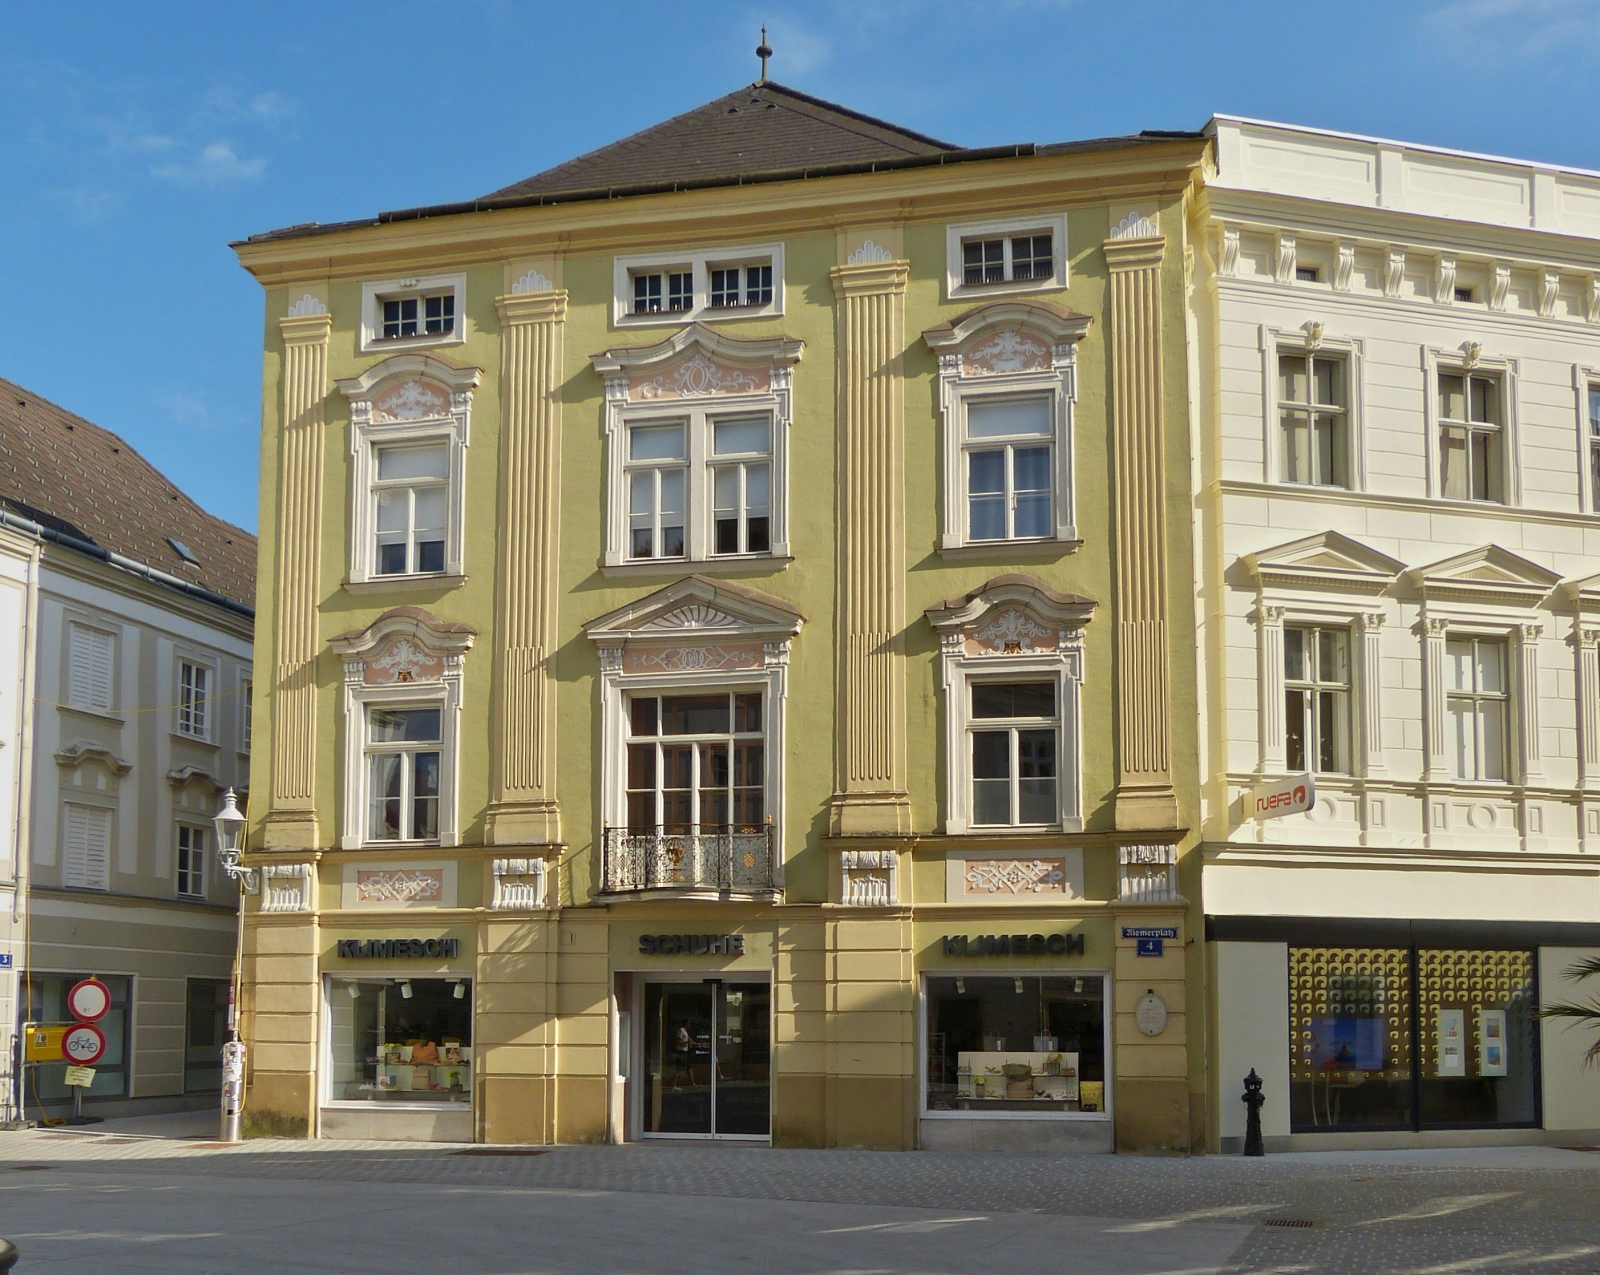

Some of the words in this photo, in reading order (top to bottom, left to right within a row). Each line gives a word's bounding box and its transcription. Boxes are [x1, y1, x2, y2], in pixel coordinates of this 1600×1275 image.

[1256, 791, 1292, 812] ruefa
[1126, 928, 1174, 938] Riemerplatz
[337, 938, 458, 958] KLIMESCH
[638, 934, 745, 955] SCHUHE
[942, 934, 1085, 956] KLIMESCH
[1145, 941, 1154, 950] 4
